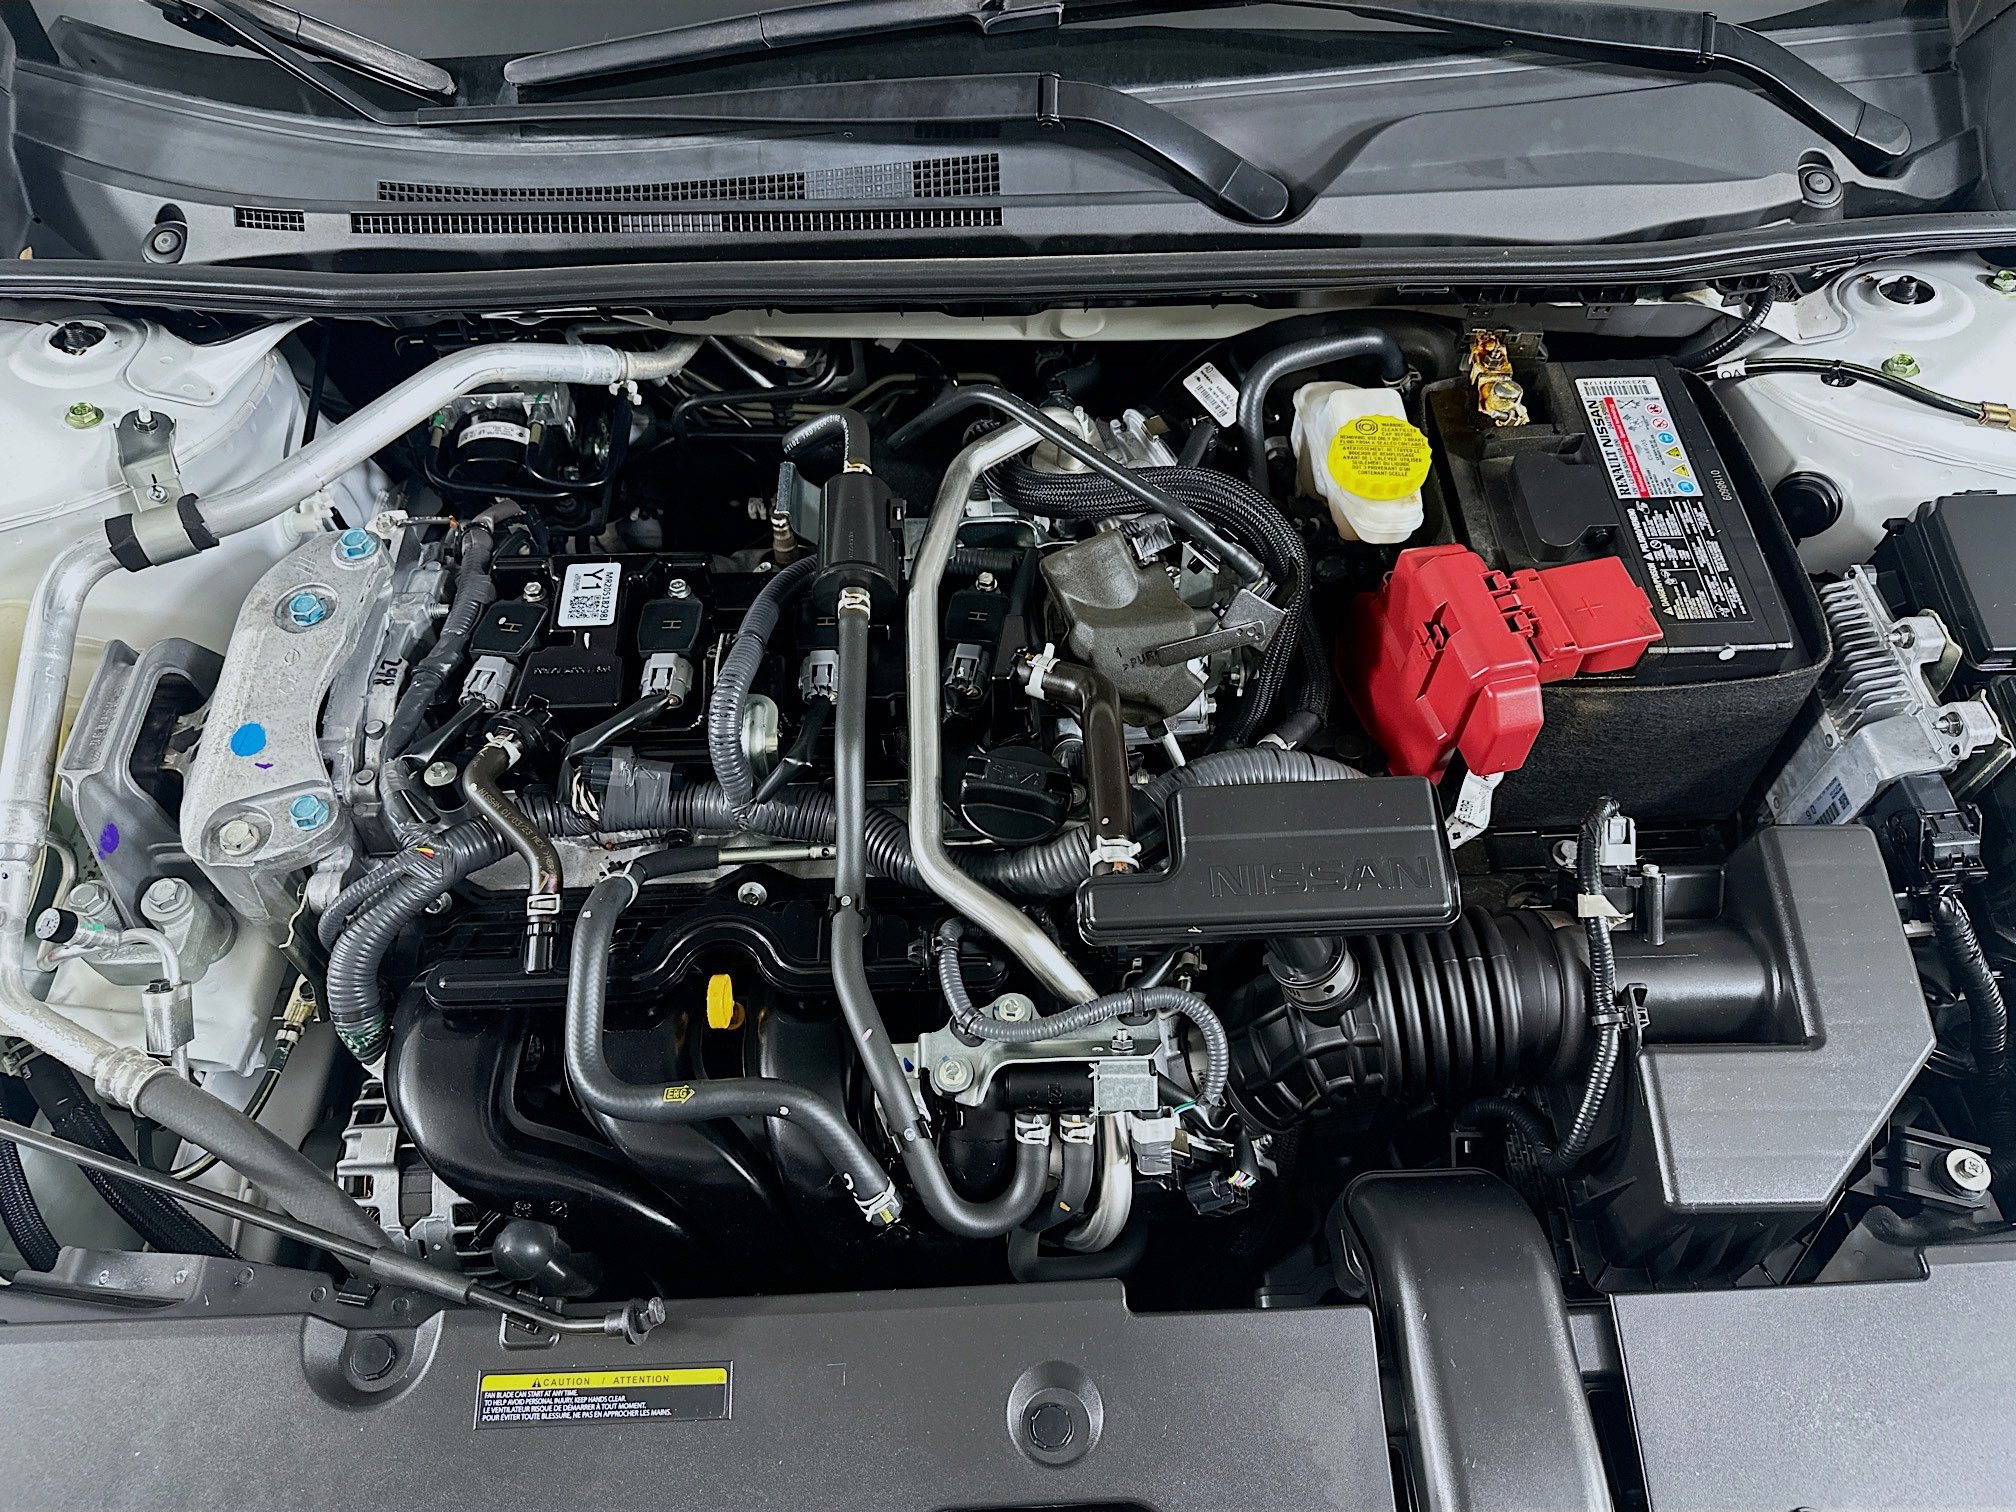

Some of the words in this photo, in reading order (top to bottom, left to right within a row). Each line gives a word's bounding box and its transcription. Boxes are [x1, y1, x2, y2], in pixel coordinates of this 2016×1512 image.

[1586, 401, 1613, 447] NISSAN
[1604, 451, 1632, 495] RENAULT
[582, 568, 604, 590] Y1
[479, 788, 502, 810] NISSAN
[1209, 856, 1434, 898] NISSAN
[544, 1378, 590, 1386] CAUTION
[613, 1376, 669, 1384] ATTENTION
